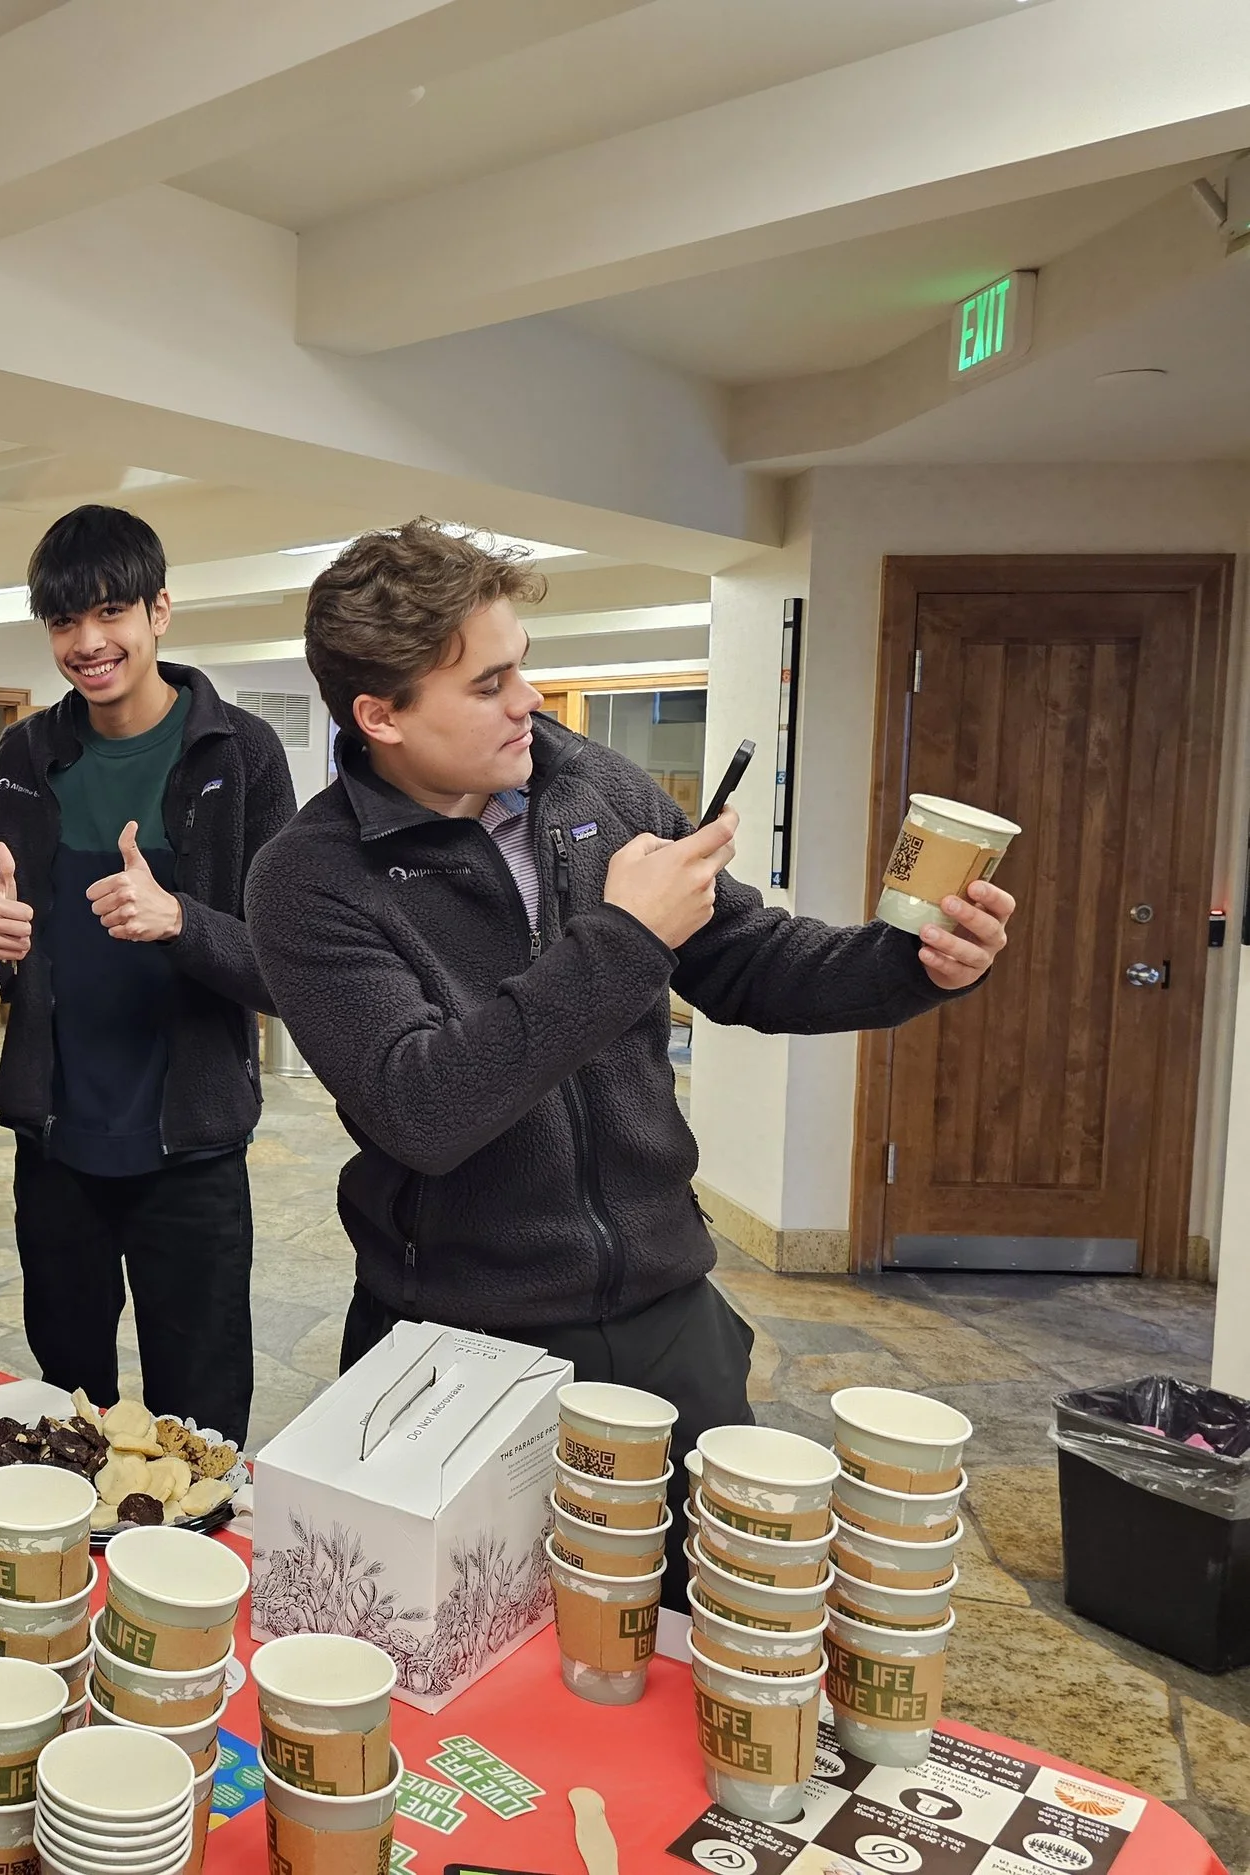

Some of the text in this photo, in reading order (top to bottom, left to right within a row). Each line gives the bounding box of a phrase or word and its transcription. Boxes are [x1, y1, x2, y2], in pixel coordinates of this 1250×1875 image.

[958, 279, 1010, 371] EXIT
[782, 671, 790, 684] 6
[778, 773, 786, 784] 5
[773, 873, 780, 885] 4
[407, 1382, 465, 1441] Do Not Microwave
[500, 1450, 514, 1462] THE
[514, 1433, 544, 1454] PARADISE
[625, 1604, 658, 1633] LIVE
[107, 1616, 150, 1662] LIFE
[857, 1660, 910, 1692] LIFE
[828, 1671, 924, 1719] GIVE LIFE
[700, 1695, 746, 1738] LIFE
[263, 1732, 310, 1776] LIFE
[717, 1734, 767, 1772] LIFE
[956, 1741, 984, 1754] save
[449, 1738, 536, 1795] GIVE LIFE
[950, 1760, 967, 1771] QR
[952, 1751, 993, 1768] coffee
[984, 1752, 1012, 1764] help
[1012, 1760, 1026, 1770] to
[930, 1777, 947, 1786] die
[932, 1771, 969, 1788] waiting
[970, 1768, 989, 1779] the
[994, 1766, 1024, 1780] your
[399, 1774, 453, 1805] GIVE
[436, 1753, 524, 1814] LIVE LIFE
[972, 1786, 992, 1796] day
[992, 1776, 1021, 1790] Scan
[950, 1784, 984, 1800] people
[400, 1795, 455, 1828] LIVE
[854, 1807, 874, 1820] way
[892, 1809, 938, 1830] donation
[1038, 1810, 1058, 1820] one
[1042, 1805, 1110, 1832] tissue donor
[706, 1811, 798, 1852] as organ donors in
[754, 1824, 772, 1835] the
[856, 1802, 966, 1848] that allows for organ
[886, 1820, 898, 1830] in
[899, 1825, 918, 1836] die
[1037, 1816, 1104, 1844] lives can be
[1076, 1822, 1110, 1838] saved
[702, 1816, 792, 1858] of people register
[730, 1835, 755, 1850] 54%
[949, 1844, 962, 1854] in
